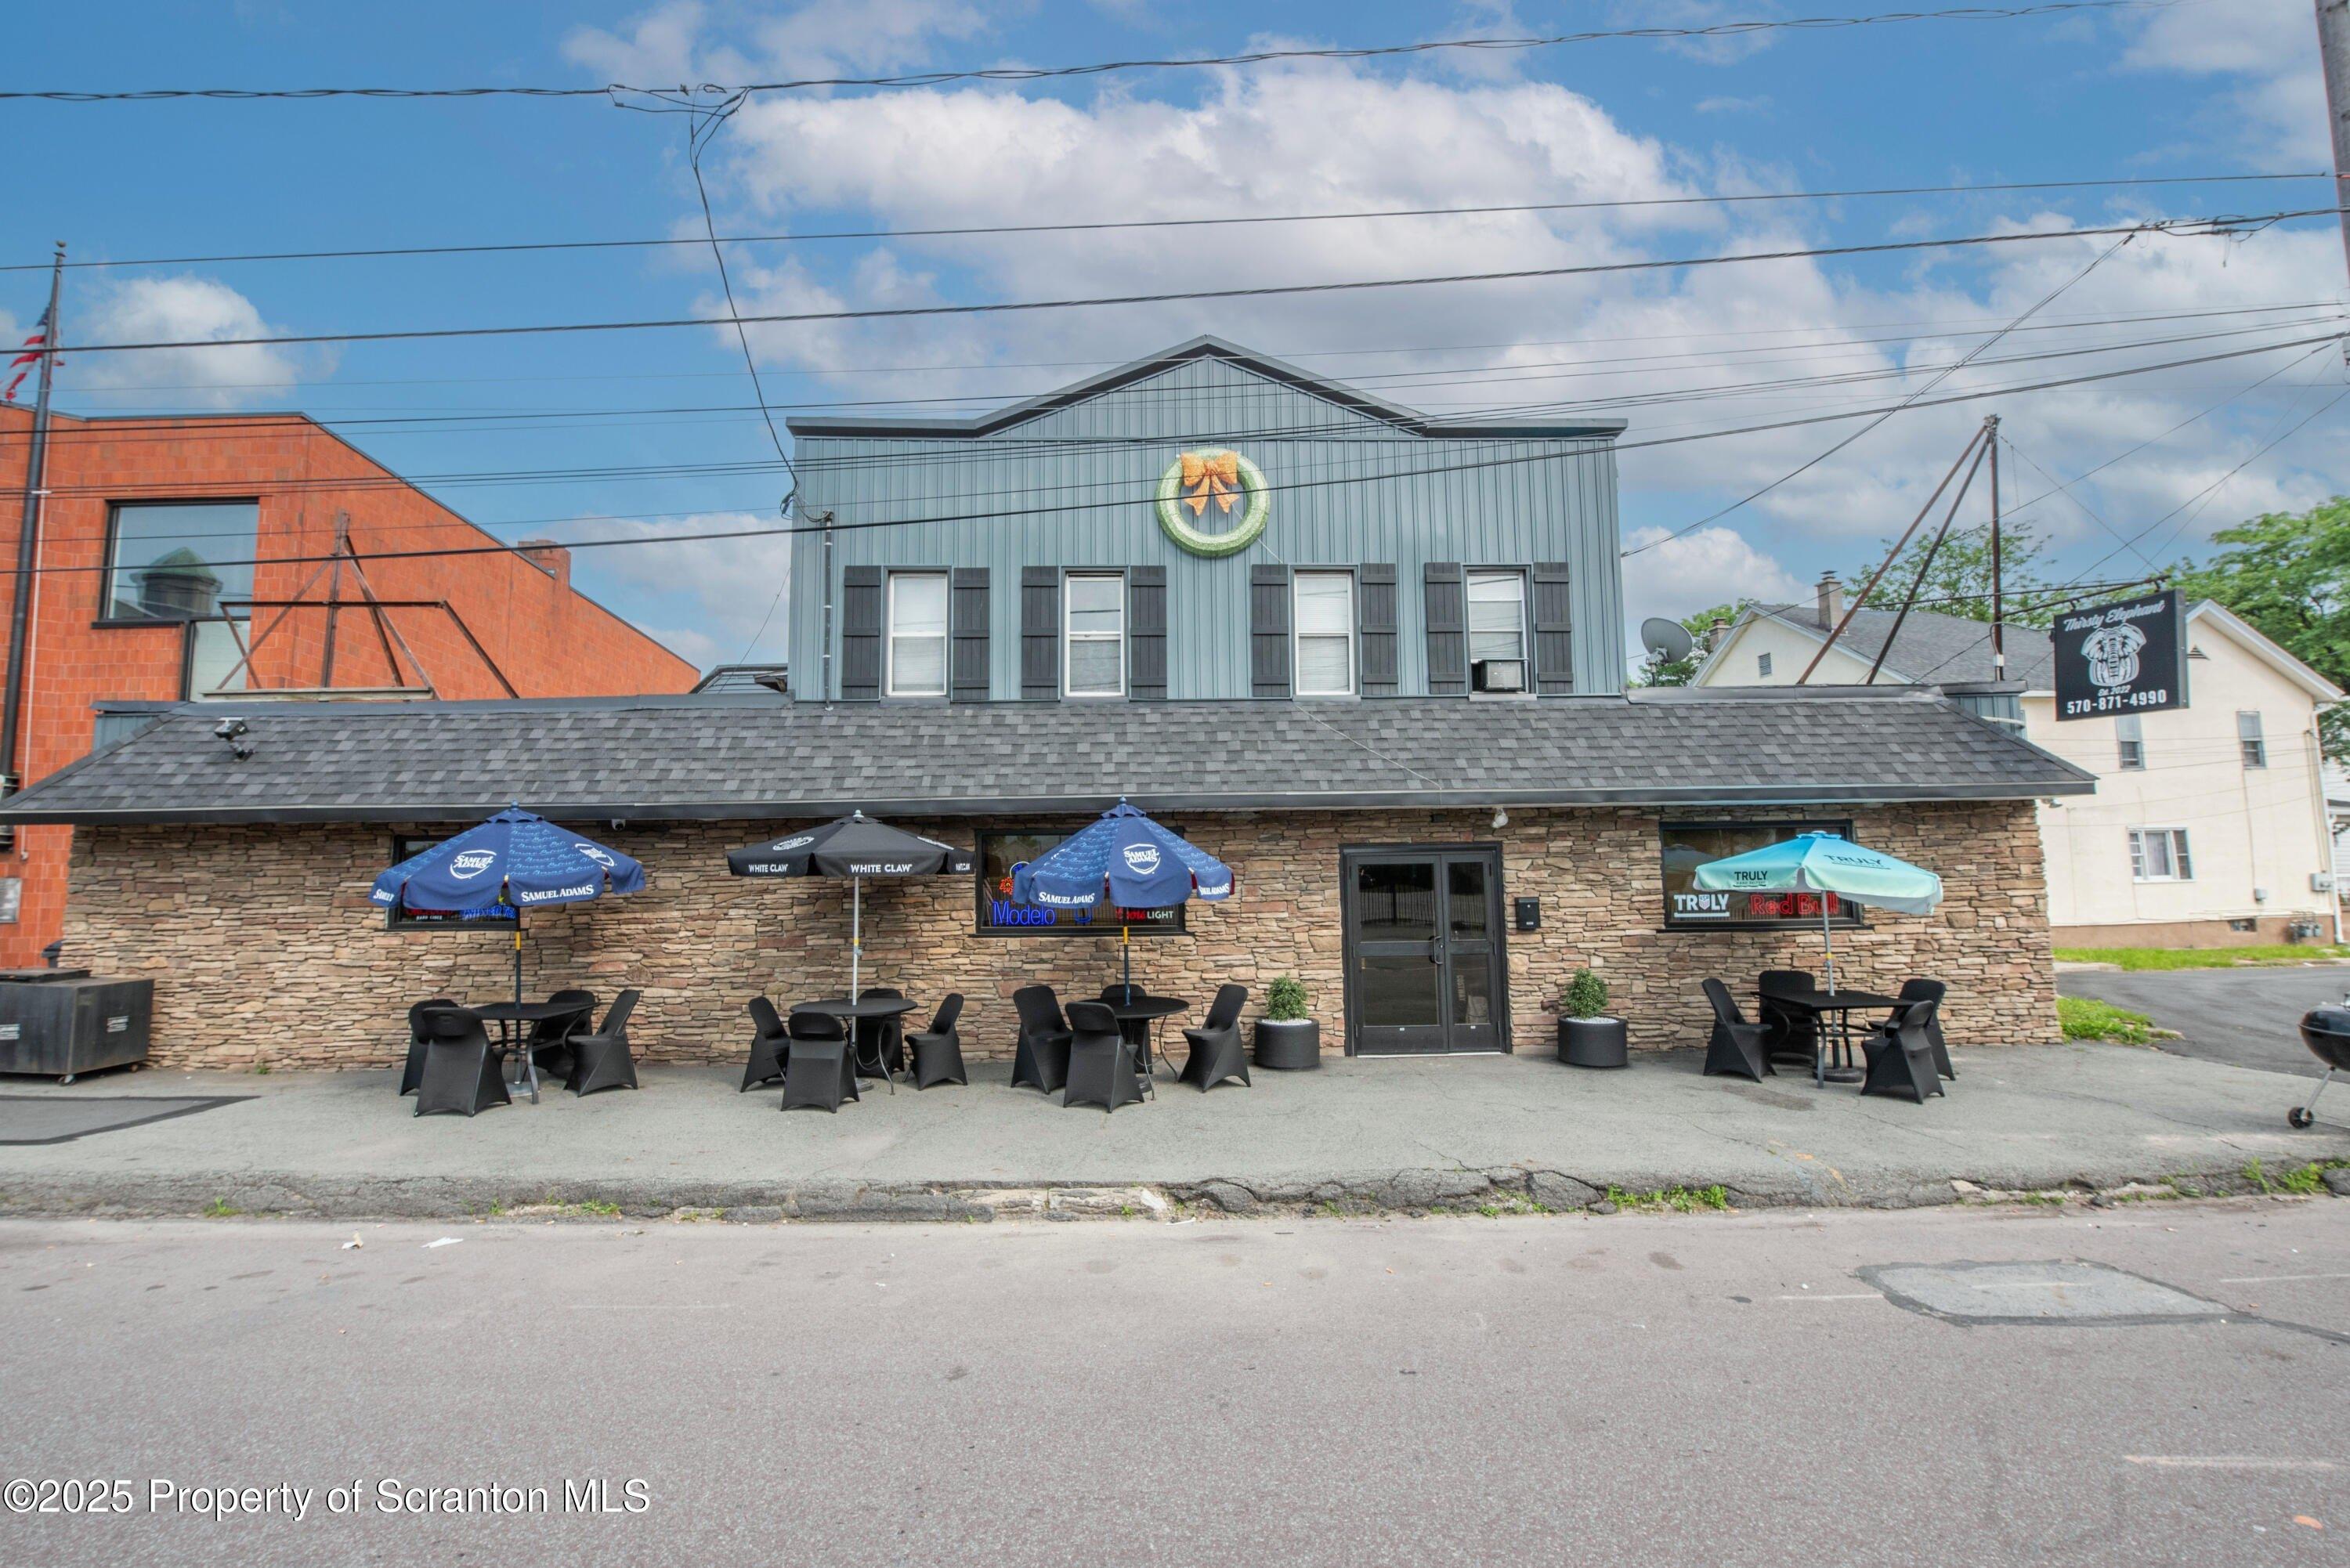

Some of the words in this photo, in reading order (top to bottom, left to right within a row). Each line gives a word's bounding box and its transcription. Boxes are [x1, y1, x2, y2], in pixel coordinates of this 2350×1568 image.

[2063, 614, 2105, 631] Thirsty
[2105, 600, 2165, 623] Elephant
[2066, 689, 2167, 714] 570-871-4990
[454, 854, 494, 864] SAMUEL
[1123, 849, 1159, 858] SAMUEL
[1824, 854, 1881, 865] TRULY
[748, 864, 768, 873] WHITE
[770, 863, 788, 873] CLAW
[851, 864, 881, 873] WHITE
[884, 863, 911, 873] CLAW
[1734, 870, 1768, 880] TRULY
[521, 891, 559, 902] SAMUEL
[559, 884, 594, 898] ADAMS
[1038, 891, 1071, 904] SAMUEL
[1072, 893, 1094, 904] ADAMS
[1750, 892, 1793, 915] Red
[992, 901, 1056, 926] Modelo
